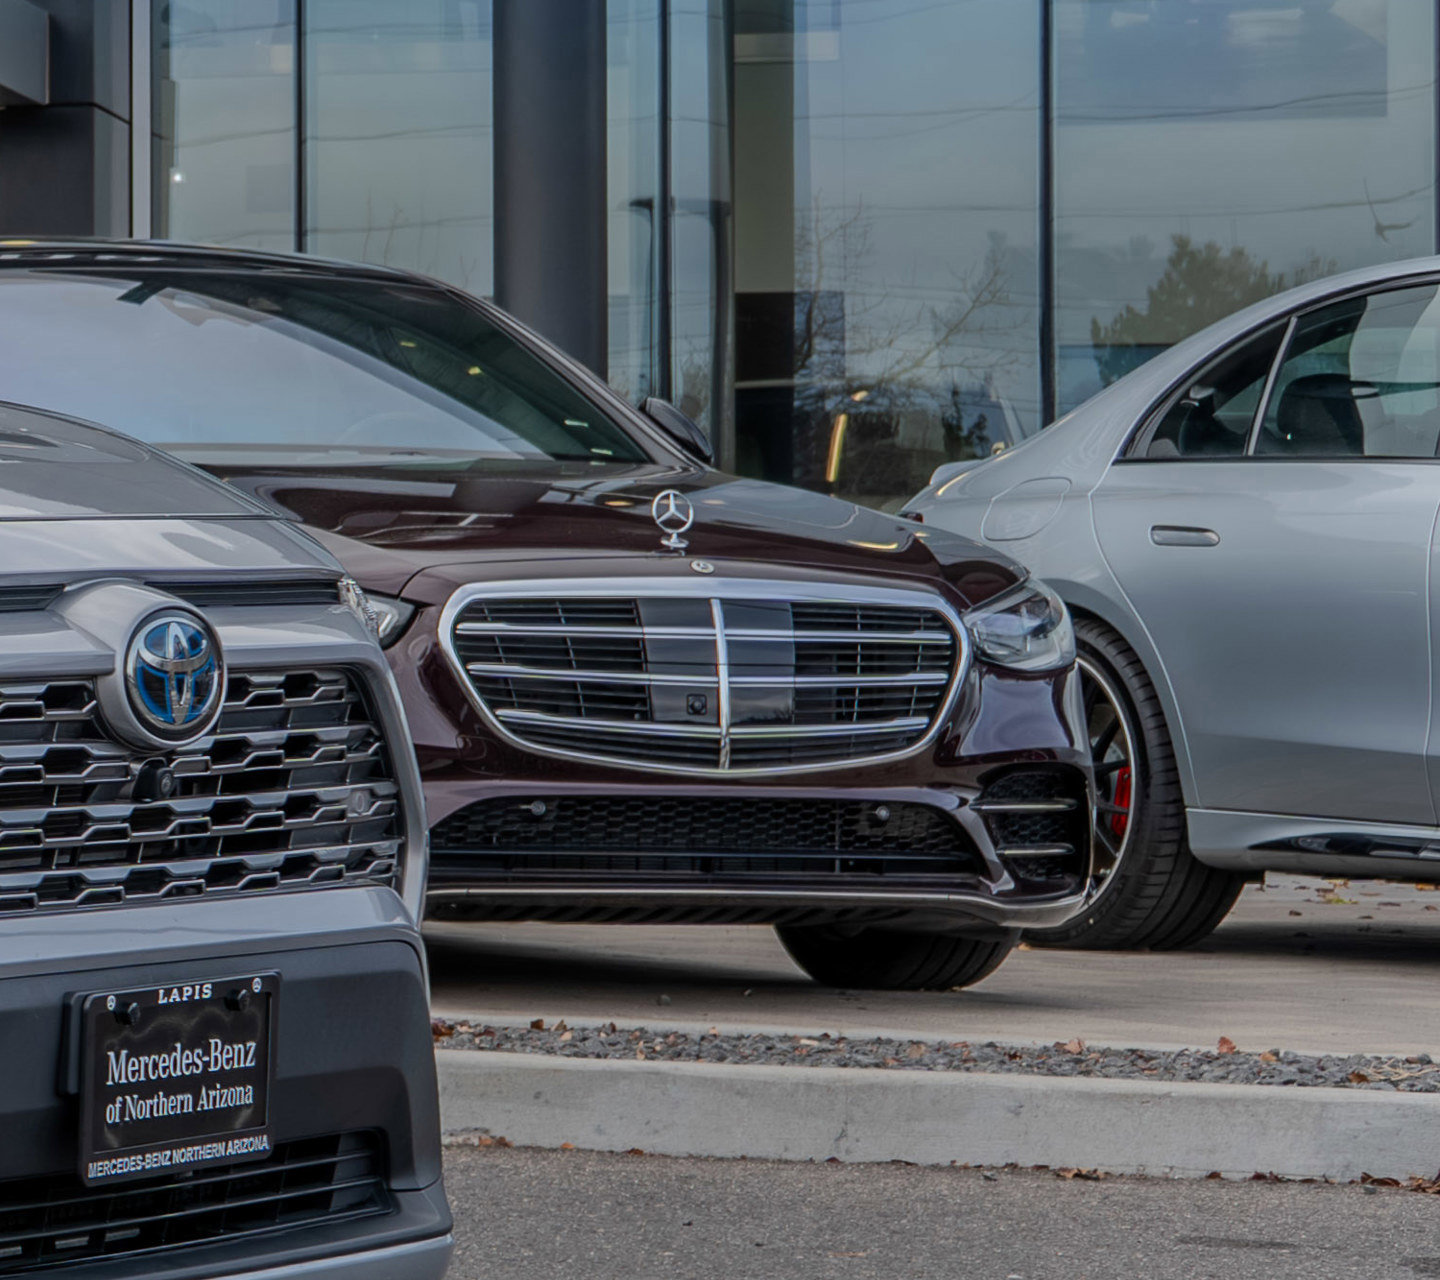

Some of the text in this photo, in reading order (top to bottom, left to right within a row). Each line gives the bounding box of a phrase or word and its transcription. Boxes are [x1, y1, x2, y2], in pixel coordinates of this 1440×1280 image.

[158, 983, 212, 1004] LAPIS
[106, 1038, 256, 1086] Mercedes-Benz
[105, 1083, 253, 1124] of Northern Arizona
[88, 1134, 269, 1178] MERCEDES-BENZ NORTHERN ARIZONA
